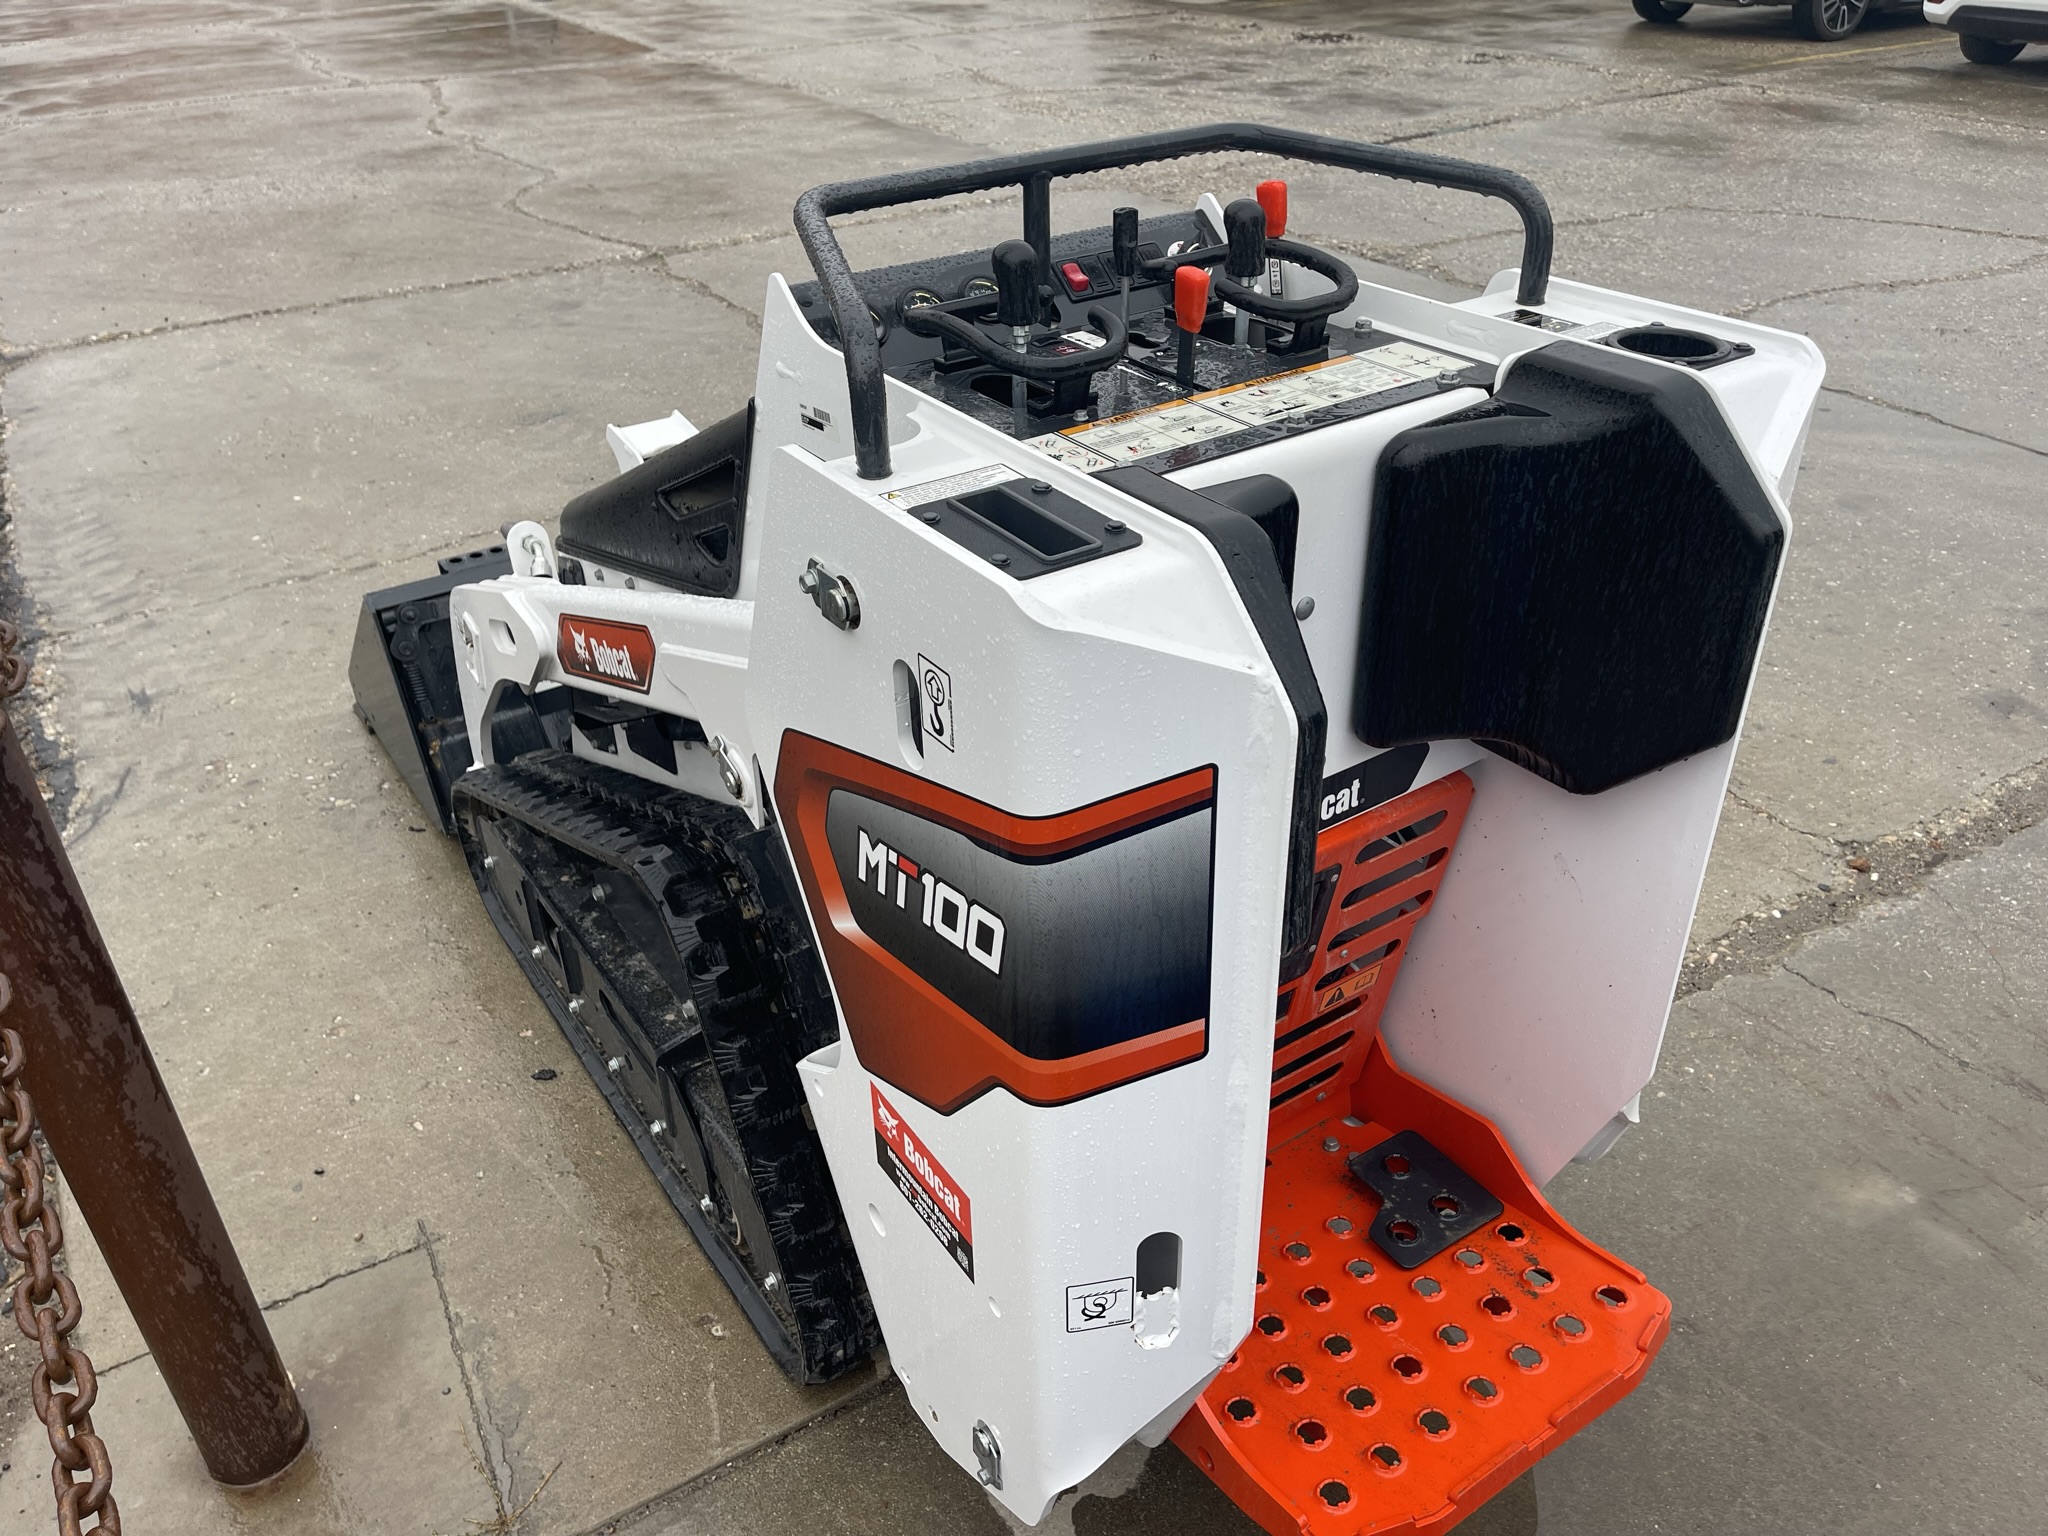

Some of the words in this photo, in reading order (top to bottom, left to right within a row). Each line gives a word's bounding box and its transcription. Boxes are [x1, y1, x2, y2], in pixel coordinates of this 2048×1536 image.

[590, 637, 636, 681] Bobcat
[858, 829, 1005, 975] MT100
[887, 1145, 933, 1209] Intermountain
[934, 1203, 960, 1242] Bobcat
[903, 1132, 962, 1223] Bobcat
